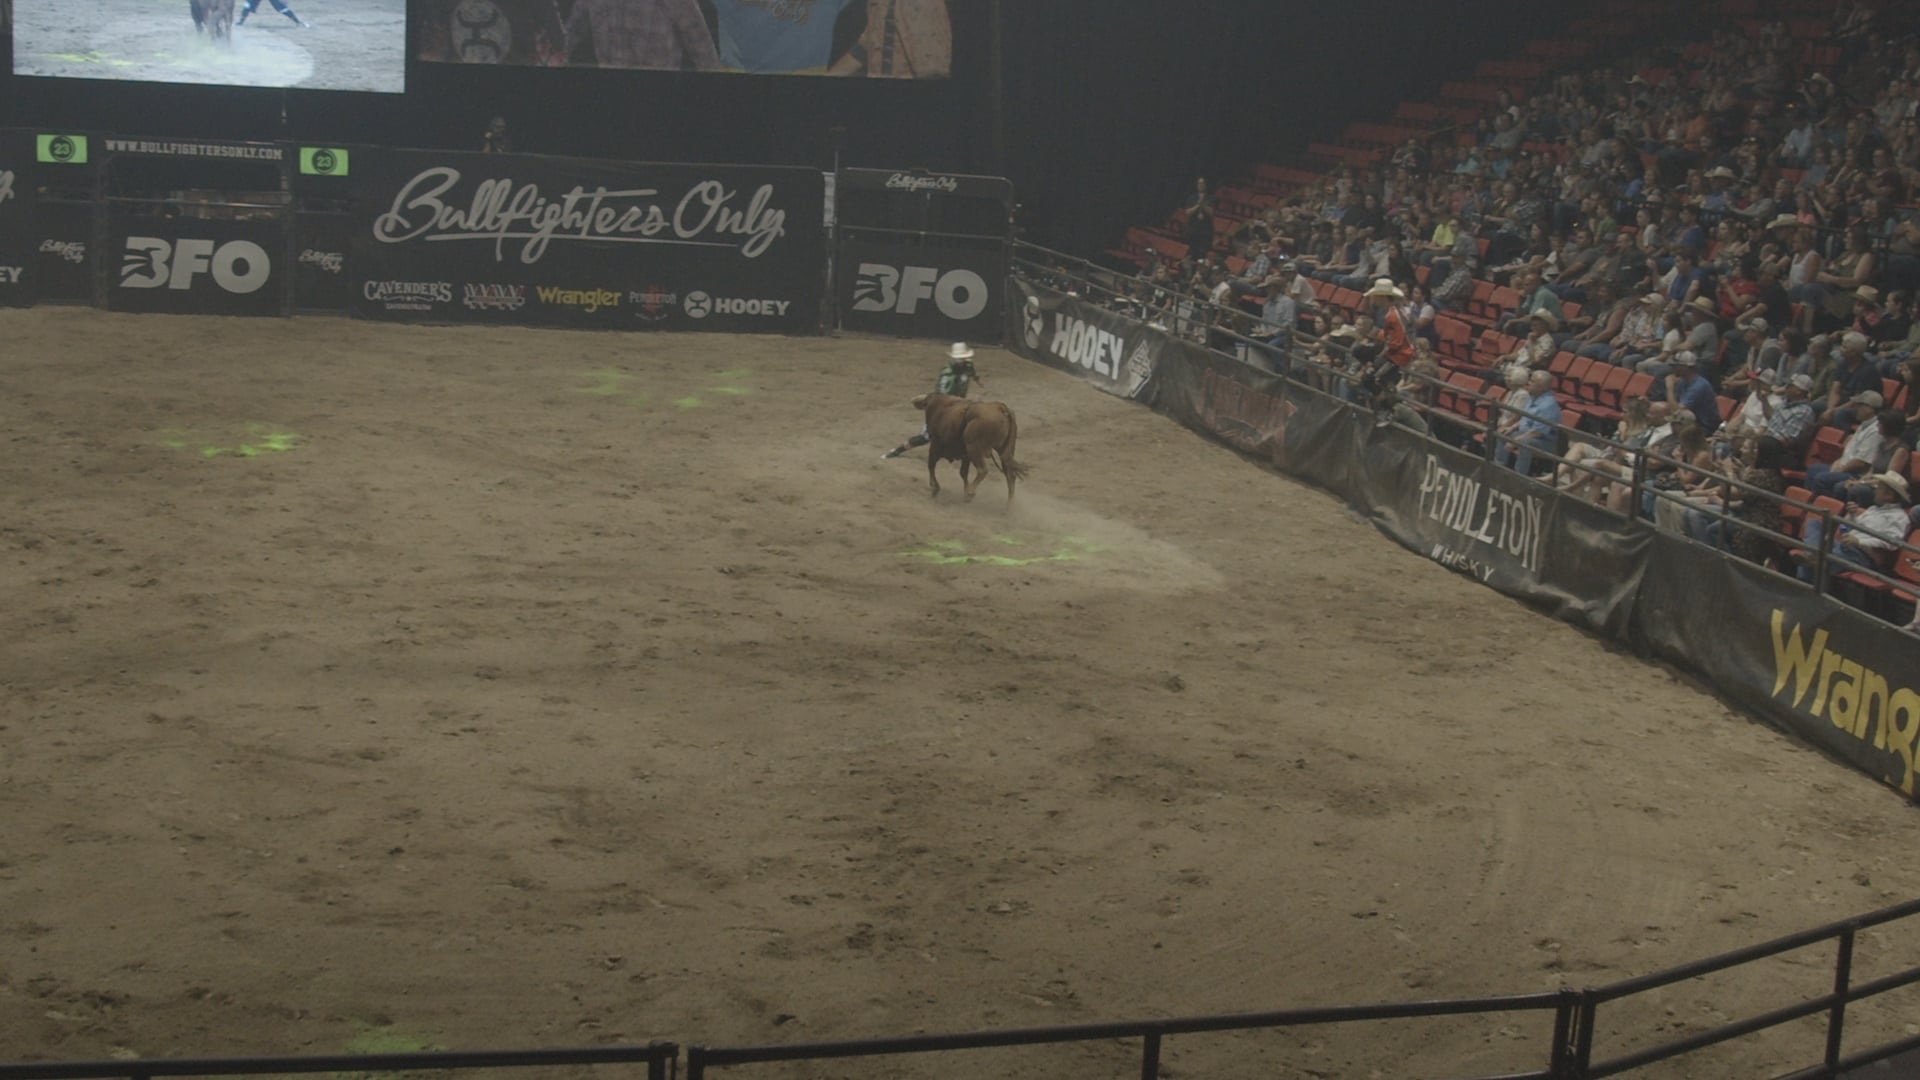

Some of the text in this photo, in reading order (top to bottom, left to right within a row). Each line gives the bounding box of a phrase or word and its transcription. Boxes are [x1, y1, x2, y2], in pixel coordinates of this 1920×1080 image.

[53, 142, 70, 155] 23
[316, 155, 332, 168] 23
[373, 166, 787, 264] Bullfighters Only
[119, 235, 271, 294] BFO
[363, 280, 453, 303] CAVENDER'S
[536, 286, 622, 313] Wrangler
[715, 297, 791, 317] HOOEY
[851, 263, 989, 320] BFO
[1051, 312, 1124, 380] HOOEY
[1419, 453, 1545, 572] PENDLETON
[1430, 542, 1496, 583] WHISKY
[1770, 608, 1920, 796] Wrang
